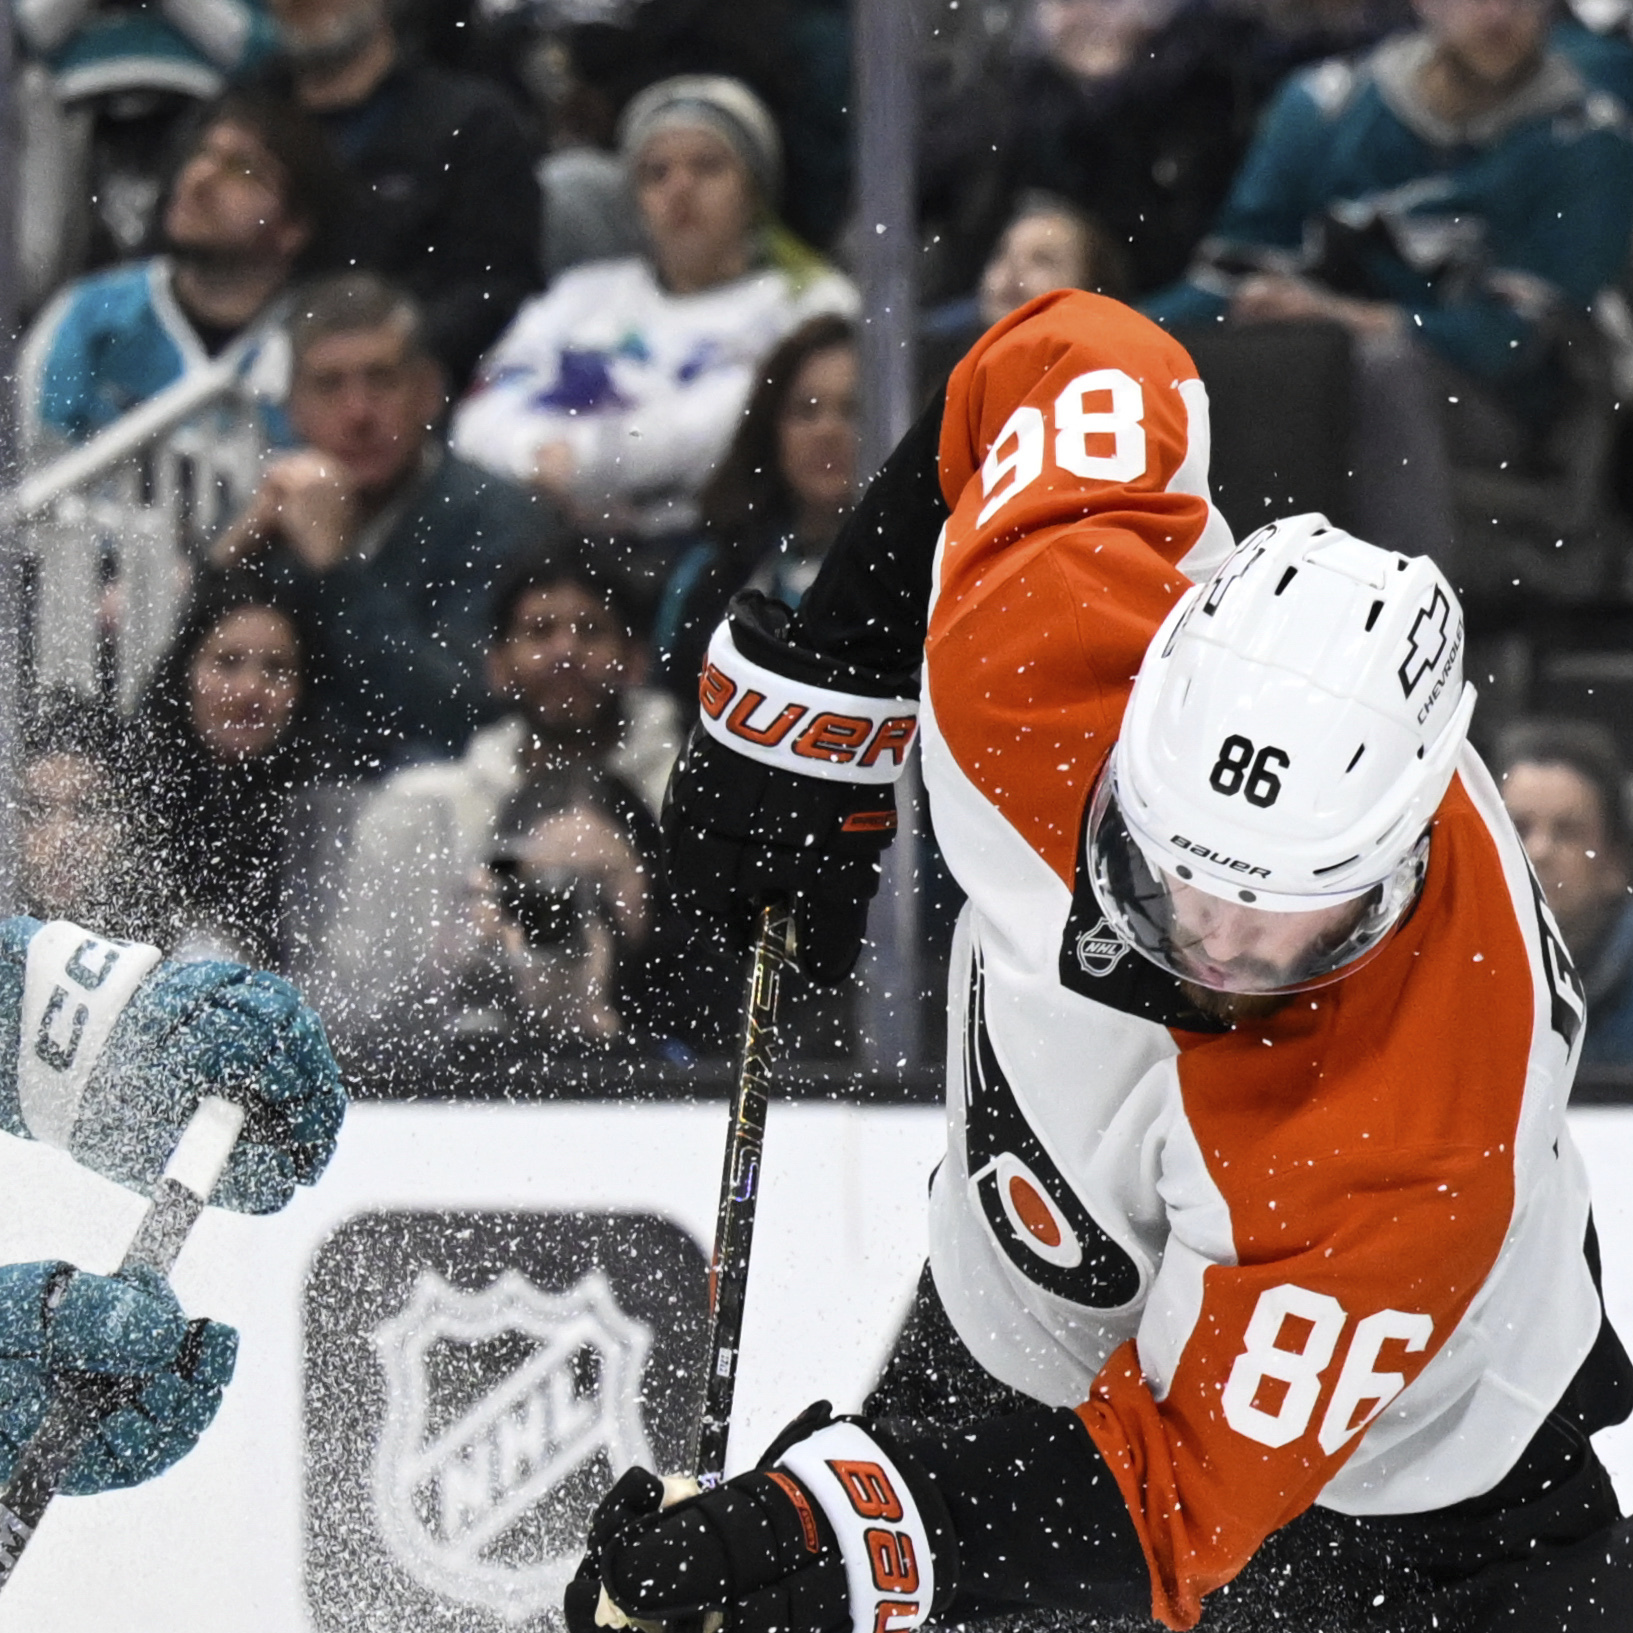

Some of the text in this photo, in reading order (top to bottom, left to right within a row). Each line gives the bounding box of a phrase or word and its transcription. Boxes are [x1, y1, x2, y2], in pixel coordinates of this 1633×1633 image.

[699, 652, 917, 767] AUER
[1209, 734, 1291, 809] 86
[1170, 834, 1272, 879] BAUER
[35, 938, 133, 1073] CC
[1085, 941, 1119, 956] NHL
[1221, 1283, 1434, 1457] 86
[438, 1362, 600, 1538] NHL
